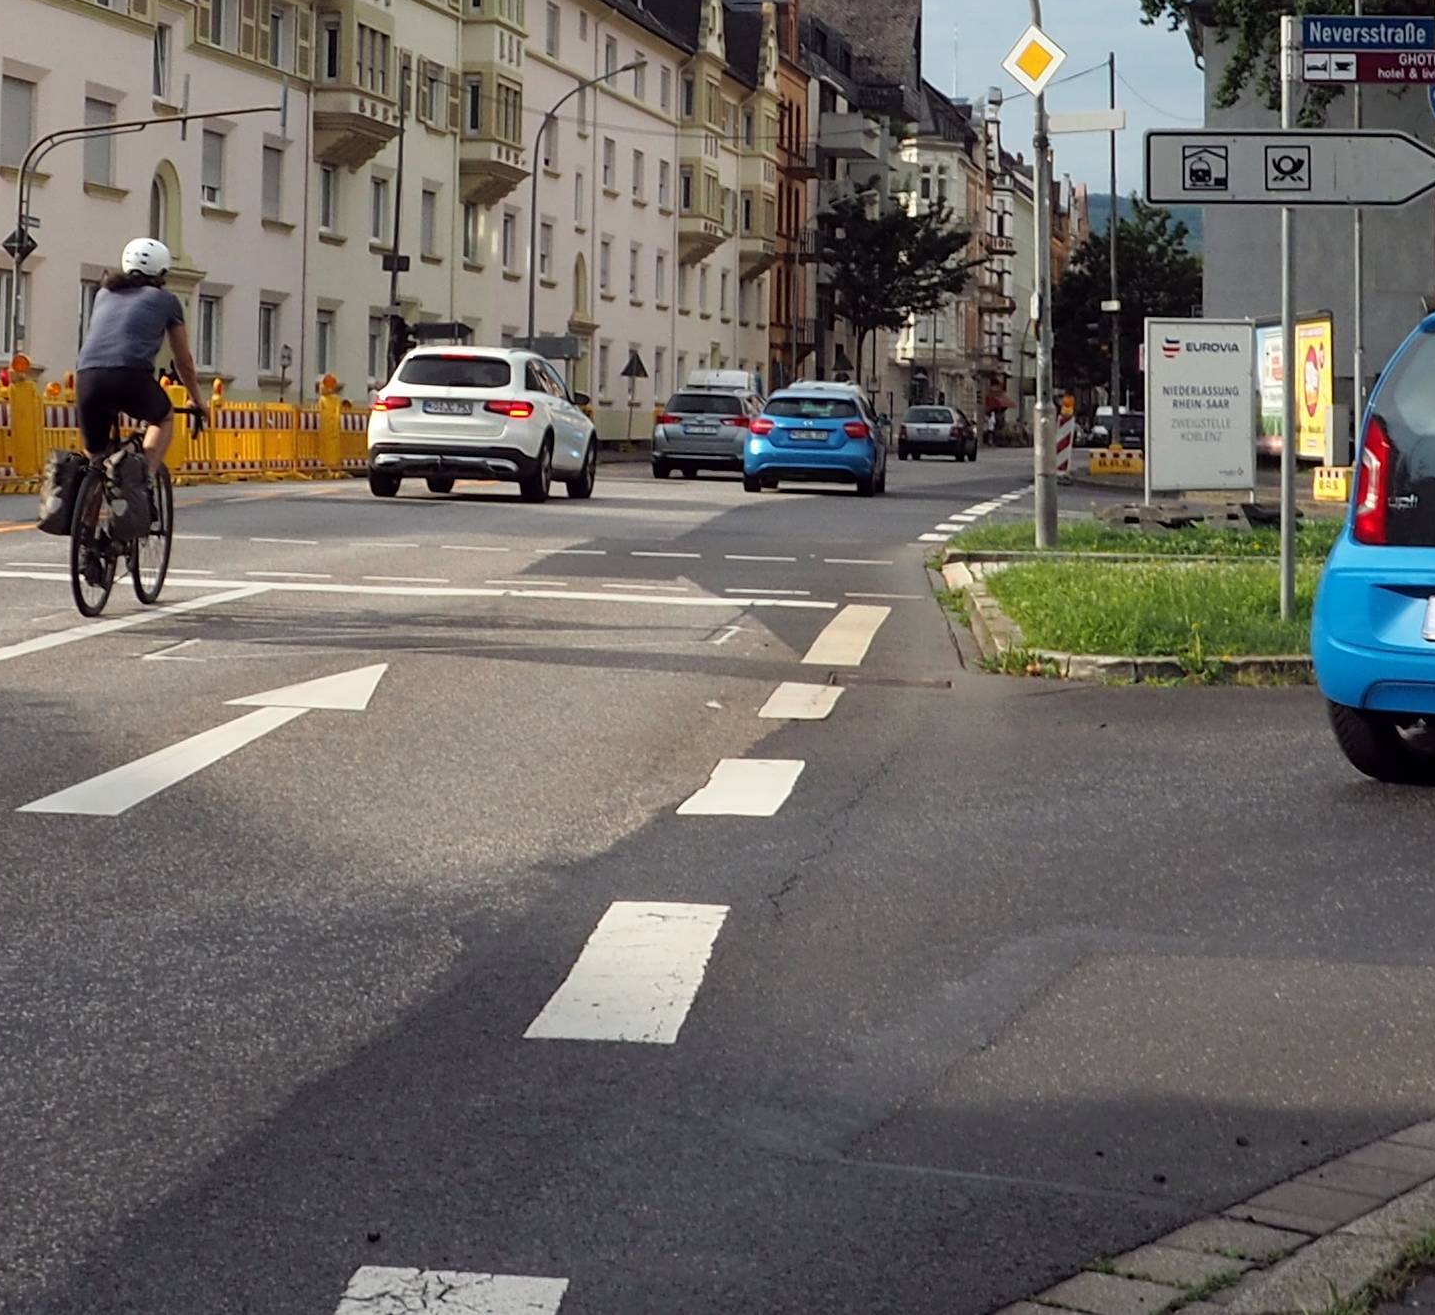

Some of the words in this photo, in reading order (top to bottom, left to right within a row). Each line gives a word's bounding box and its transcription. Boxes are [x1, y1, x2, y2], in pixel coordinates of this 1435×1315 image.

[1310, 21, 1426, 43] Neversstraße
[1378, 68, 1404, 79] hotel
[1409, 68, 1418, 79] &
[1185, 342, 1240, 353] EUROVIA
[1162, 386, 1240, 396] NIEDERLASSUNG
[1172, 399, 1230, 409] RHEIN-SAAR
[1171, 418, 1230, 429] ZWEIGSTELLE
[1180, 431, 1223, 442] KOBLENZ
